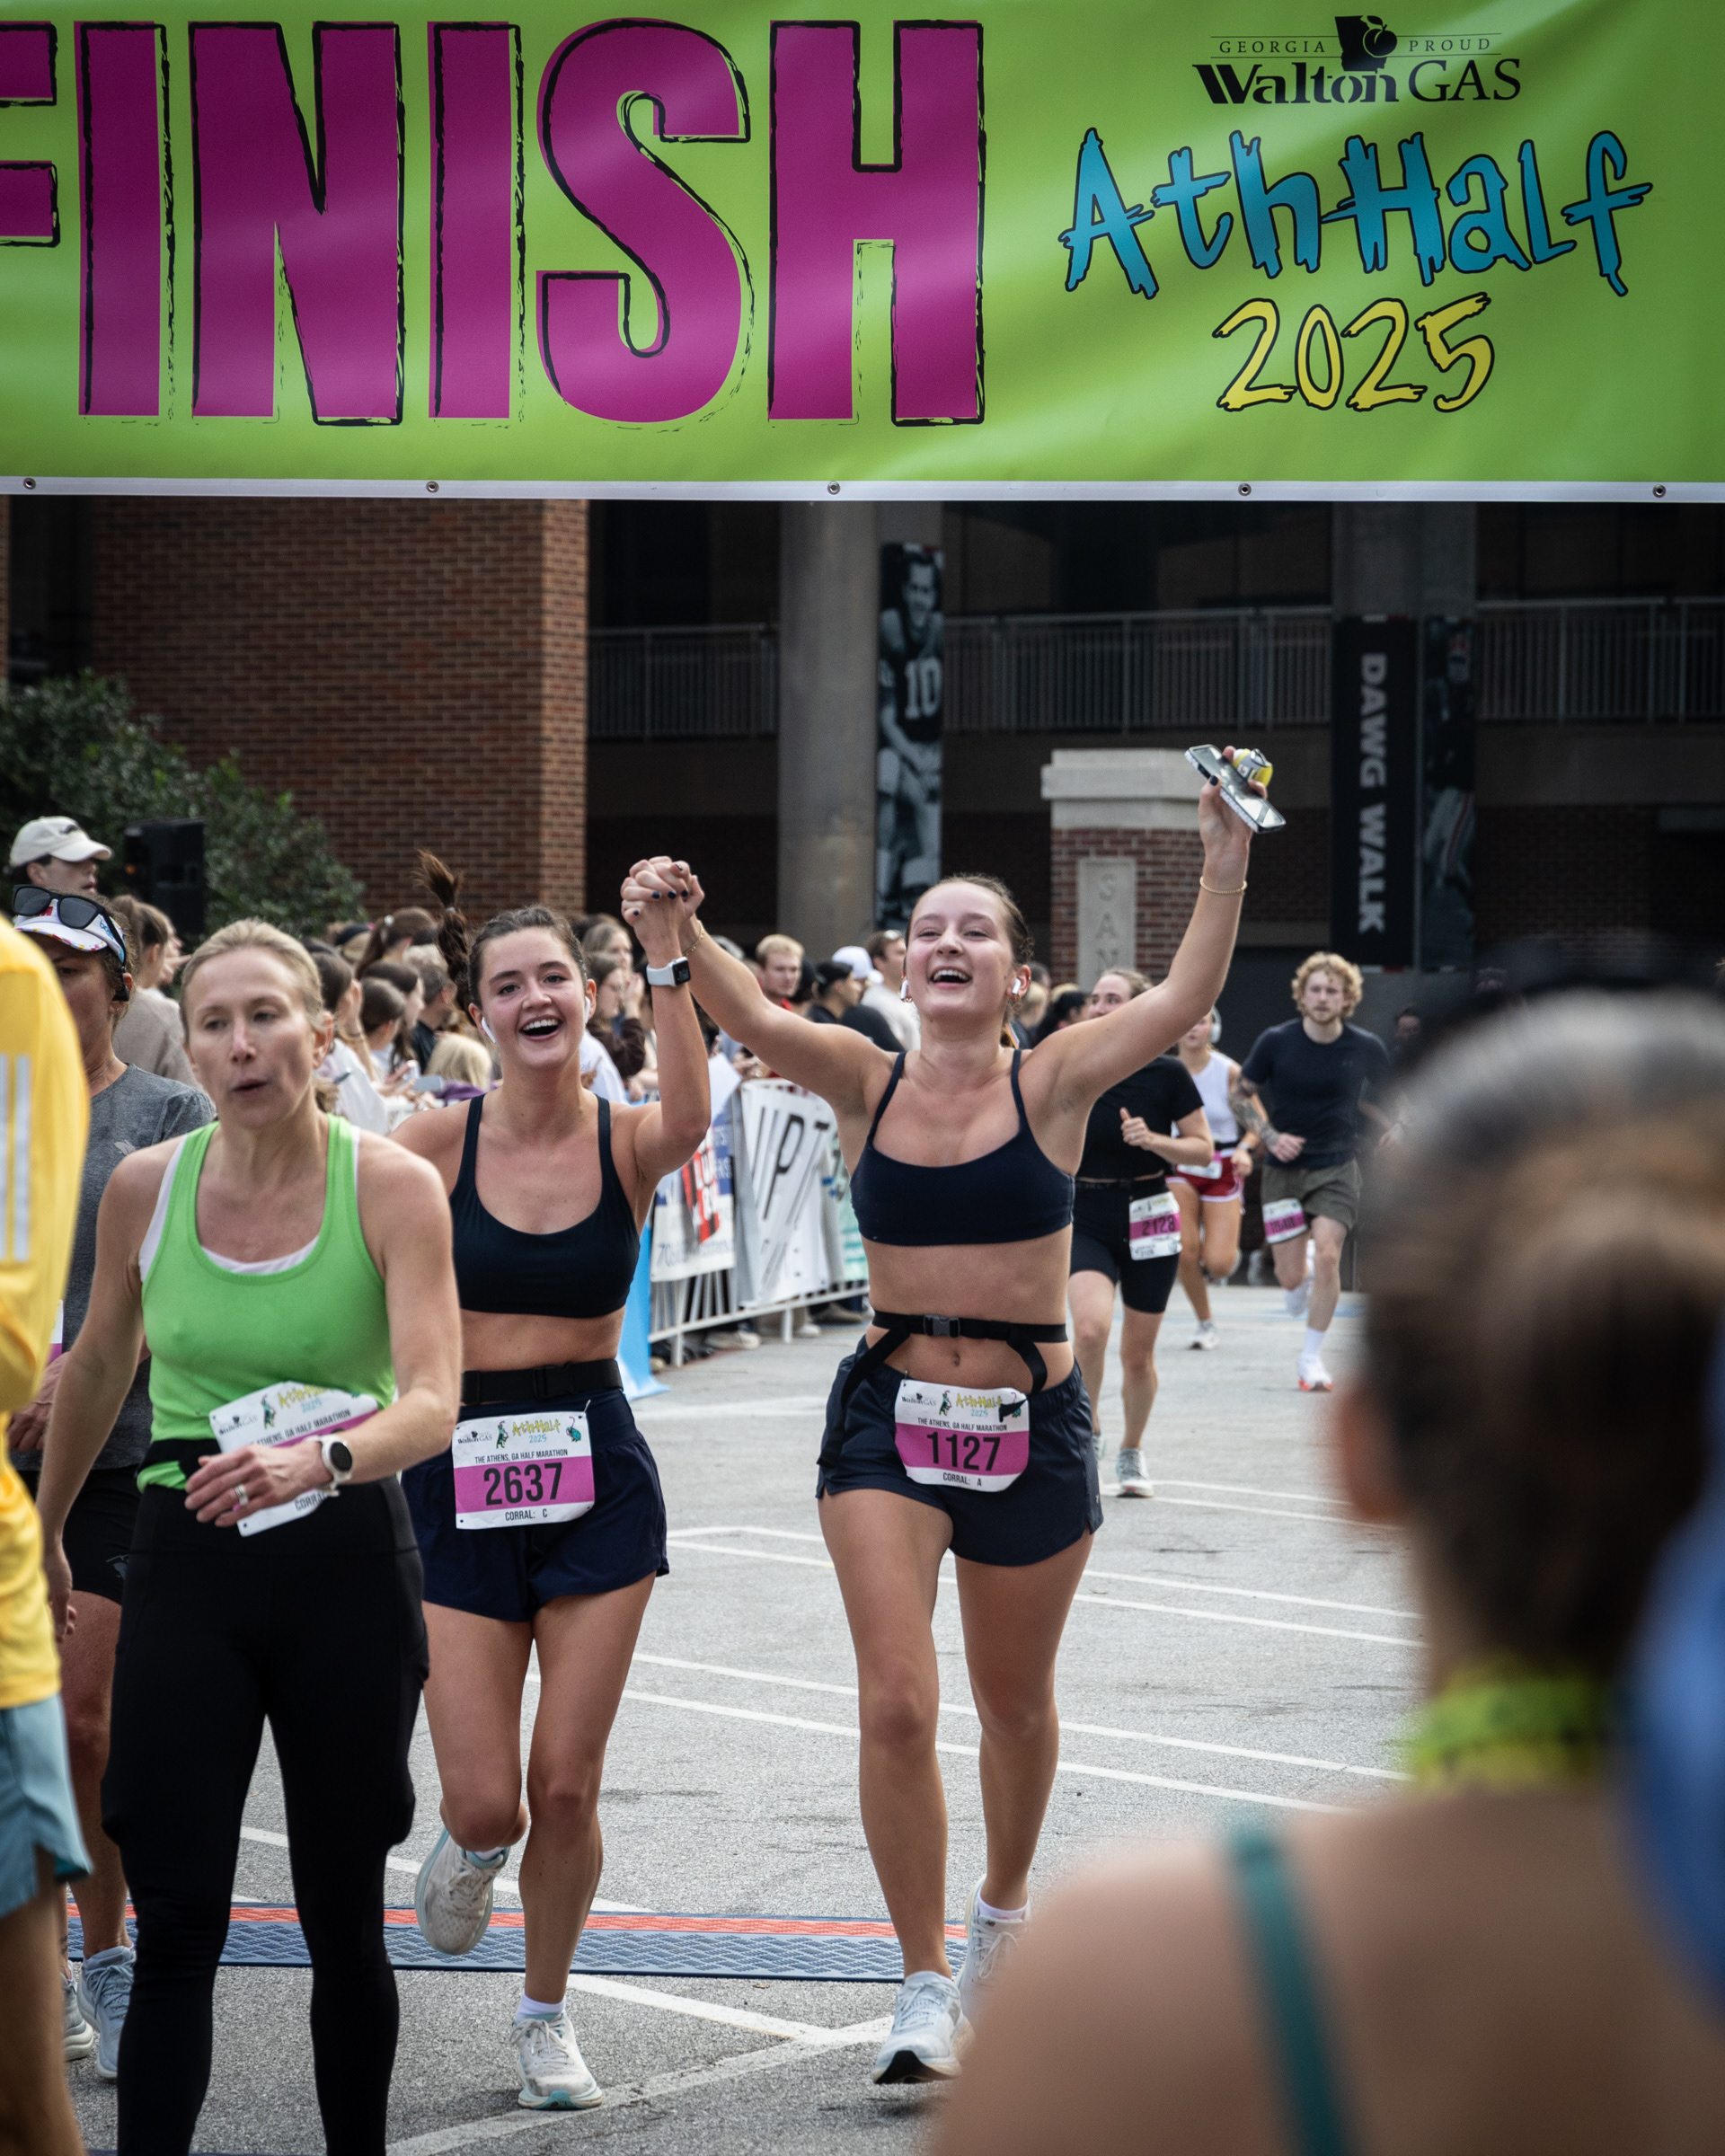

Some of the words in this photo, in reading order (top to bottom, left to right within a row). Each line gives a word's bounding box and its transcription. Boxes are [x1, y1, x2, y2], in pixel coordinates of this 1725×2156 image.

[1219, 40, 1326, 54] GEORGIA
[1409, 38, 1491, 53] PROUD
[1192, 62, 1400, 104] Walton
[1408, 58, 1521, 102] GAS
[1211, 292, 1495, 413] 2025
[1359, 652, 1389, 790] DAWG
[1358, 802, 1388, 934] WALK
[295, 1423, 313, 1436] HALF
[314, 1409, 351, 1428] MARATHON
[928, 1418, 951, 1429] ATHENS,
[976, 1424, 1008, 1432] MARATHON
[529, 1434, 547, 1444] 2025
[926, 1431, 1001, 1471] 1127
[474, 1455, 485, 1464] THE
[486, 1454, 511, 1463] ATHENS,
[511, 1453, 519, 1461] GA
[519, 1451, 535, 1460] HALF
[535, 1448, 568, 1457] MARATHON
[483, 1462, 562, 1507] 2637
[942, 1471, 971, 1486] CORRAL:
[977, 1478, 982, 1487] A
[505, 1509, 535, 1522] CORRAL:
[542, 1507, 548, 1518] C
